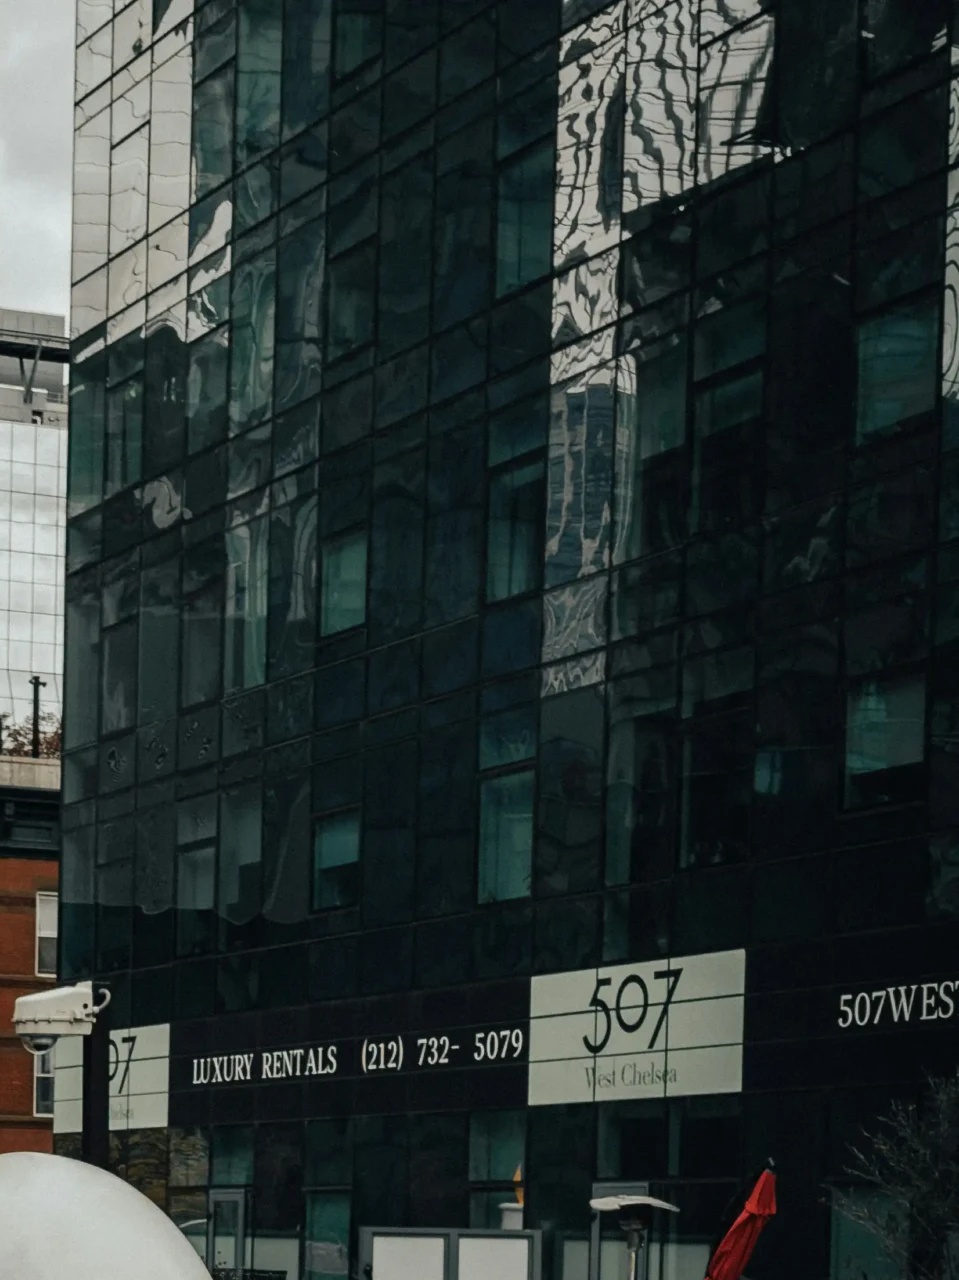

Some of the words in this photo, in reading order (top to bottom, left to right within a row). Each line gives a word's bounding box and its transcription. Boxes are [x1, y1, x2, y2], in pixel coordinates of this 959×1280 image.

[582, 967, 684, 1054] 507
[192, 1053, 254, 1084] LUXURY
[261, 1045, 338, 1079] RENTALS
[361, 1035, 404, 1073] (212)
[473, 1029, 524, 1061] 5079
[584, 1063, 616, 1088] West
[621, 1061, 678, 1087] Chelsea
